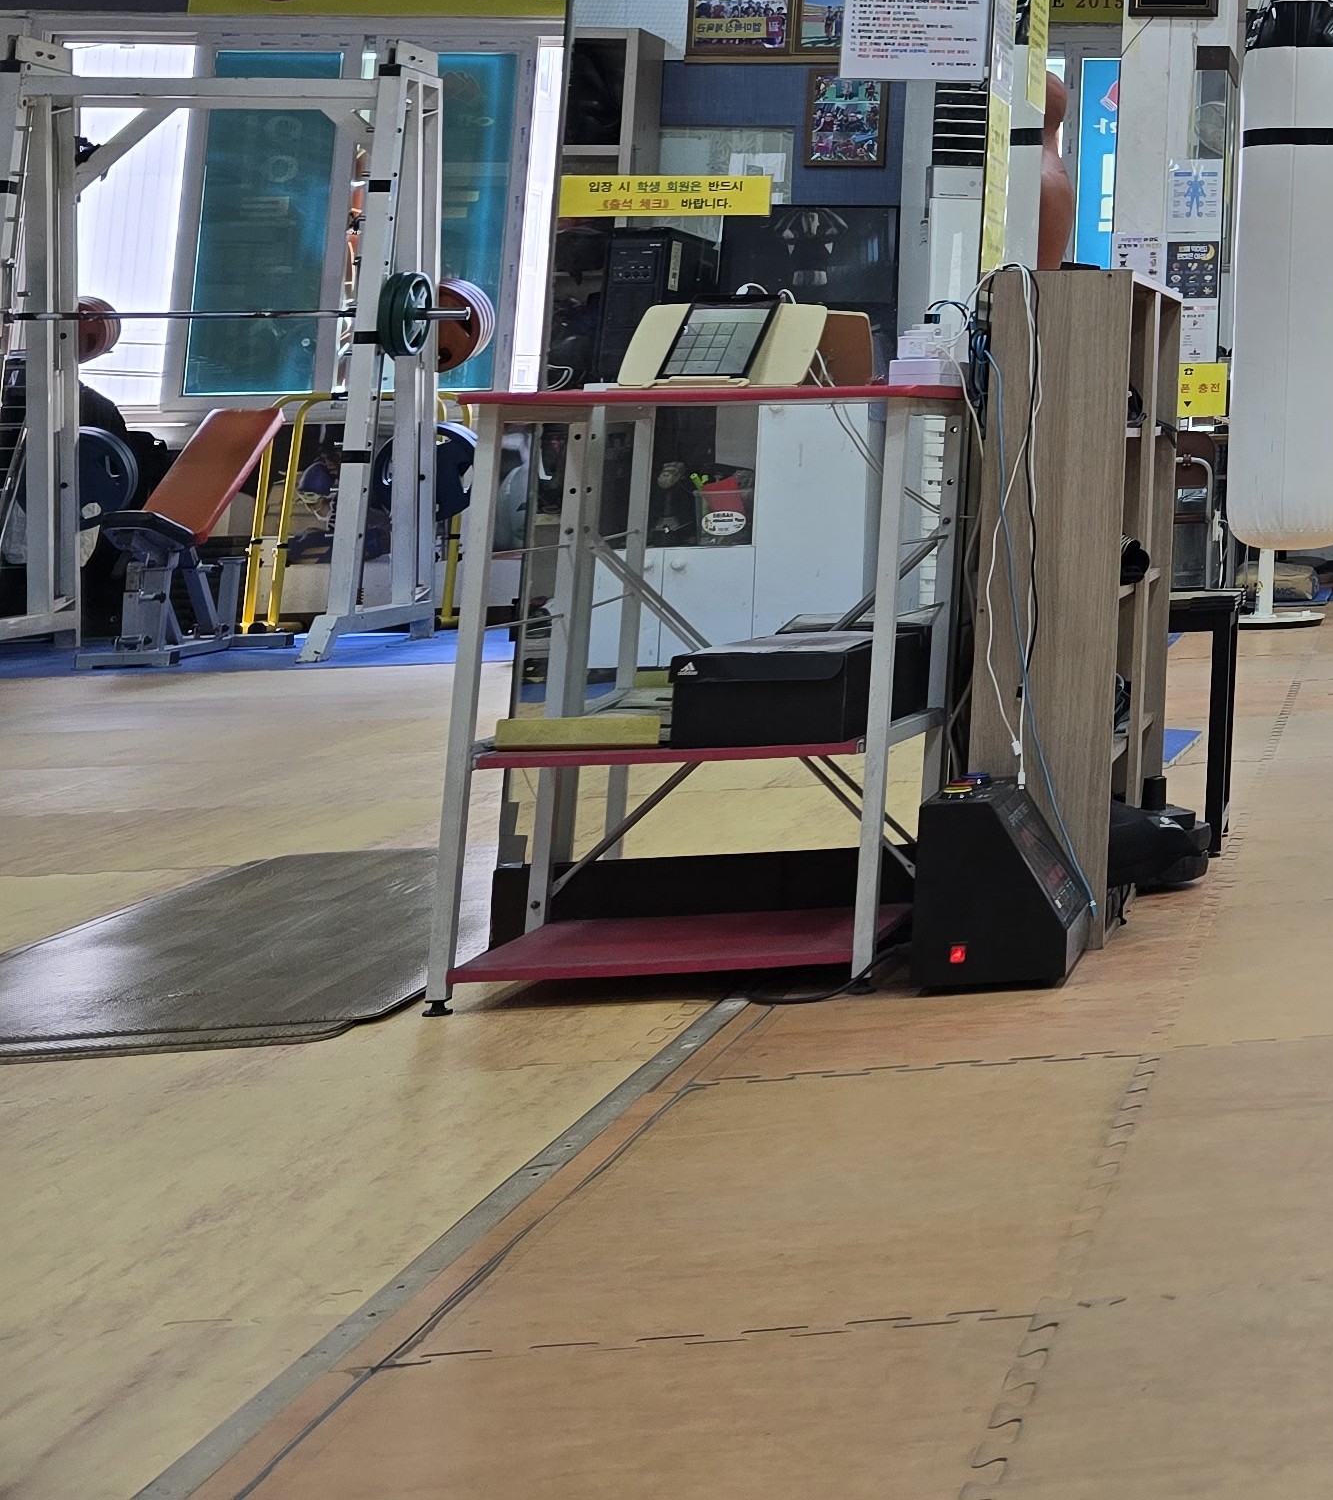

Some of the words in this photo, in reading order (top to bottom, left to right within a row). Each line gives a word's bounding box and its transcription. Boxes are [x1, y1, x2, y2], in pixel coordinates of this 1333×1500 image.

[588, 181, 613, 194] 입장
[618, 180, 631, 193] 시
[636, 181, 661, 193] 학생
[666, 180, 703, 193] 회원은
[708, 180, 744, 193] 반드시
[680, 198, 733, 210] 바랍니다.
[1180, 382, 1191, 394] 폰
